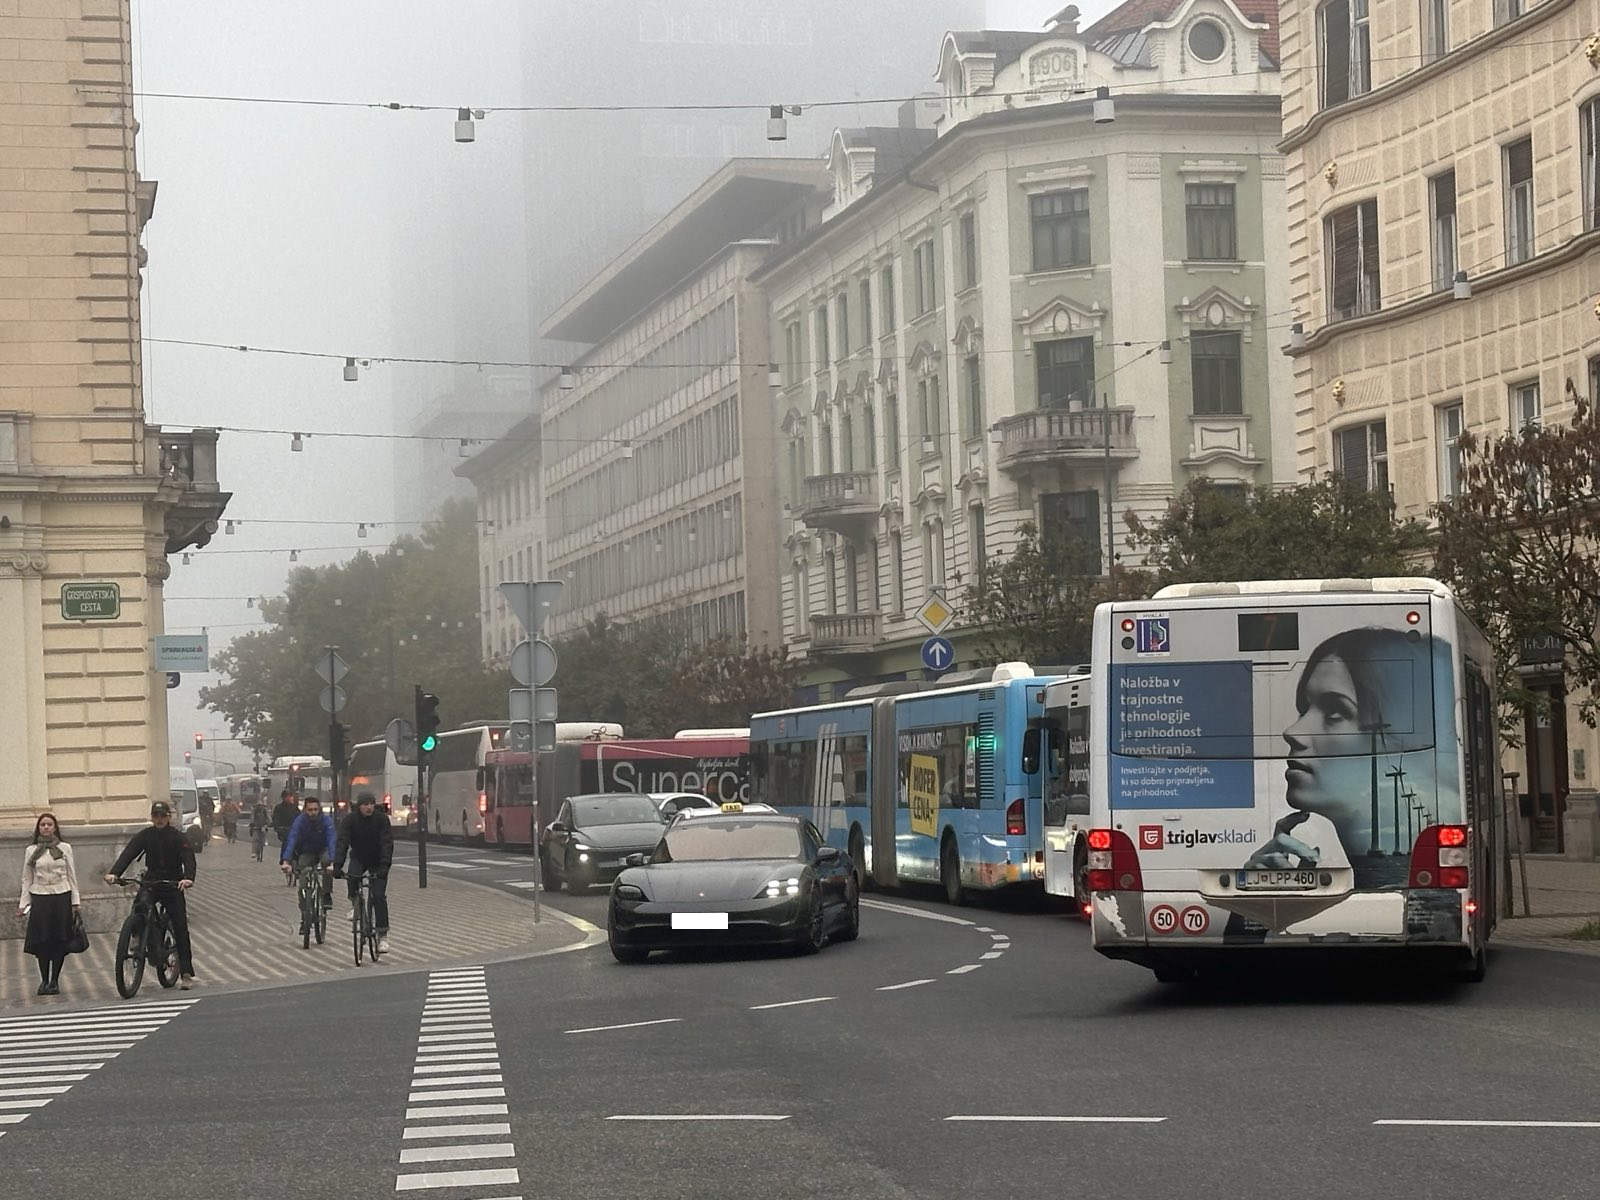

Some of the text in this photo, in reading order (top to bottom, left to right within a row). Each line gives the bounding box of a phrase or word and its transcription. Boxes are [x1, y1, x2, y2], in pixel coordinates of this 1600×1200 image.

[67, 590, 114, 600] GOSPOSVETSKA
[80, 602, 101, 612] CESTA
[1120, 676, 1180, 688] Naložba v
[1120, 694, 1183, 708] trajnostne
[1120, 709, 1191, 724] tehnologije
[1120, 727, 1202, 741] je prihodnost
[1121, 743, 1196, 757] investiranja.
[1121, 766, 1166, 777] Investirajte
[913, 766, 936, 796] HOFER
[1121, 777, 1129, 786] ki
[1140, 777, 1164, 786] dobro
[1166, 777, 1214, 789] pripravljena
[1121, 789, 1132, 797] na
[1167, 829, 1256, 848] triglavskladi
[1247, 872, 1314, 885] LJ LPP 460
[1158, 912, 1173, 927] 50
[1187, 913, 1203, 928] 70
